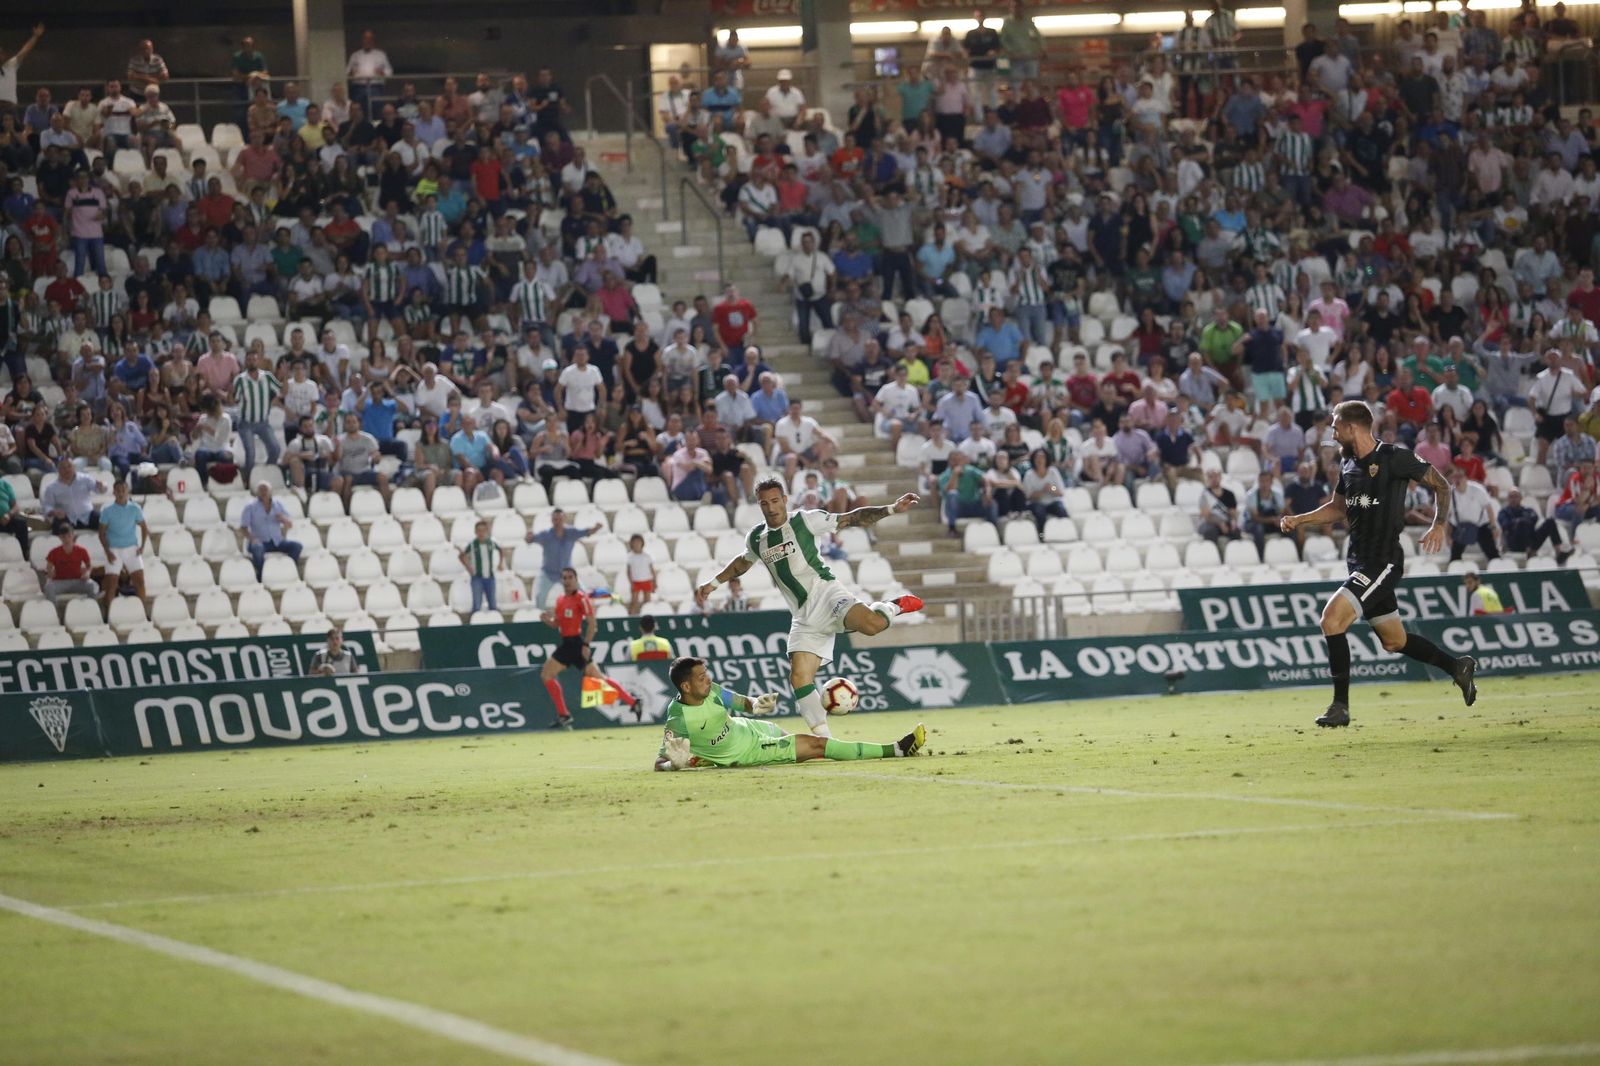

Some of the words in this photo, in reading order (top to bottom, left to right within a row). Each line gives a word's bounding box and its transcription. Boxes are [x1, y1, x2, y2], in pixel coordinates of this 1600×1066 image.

[1442, 621, 1560, 653] CLUB
[1004, 650, 1073, 682] LA
[1268, 668, 1311, 682] HOME
[1312, 662, 1408, 679] TECNOLOGY
[1478, 654, 1542, 670] PADEL
